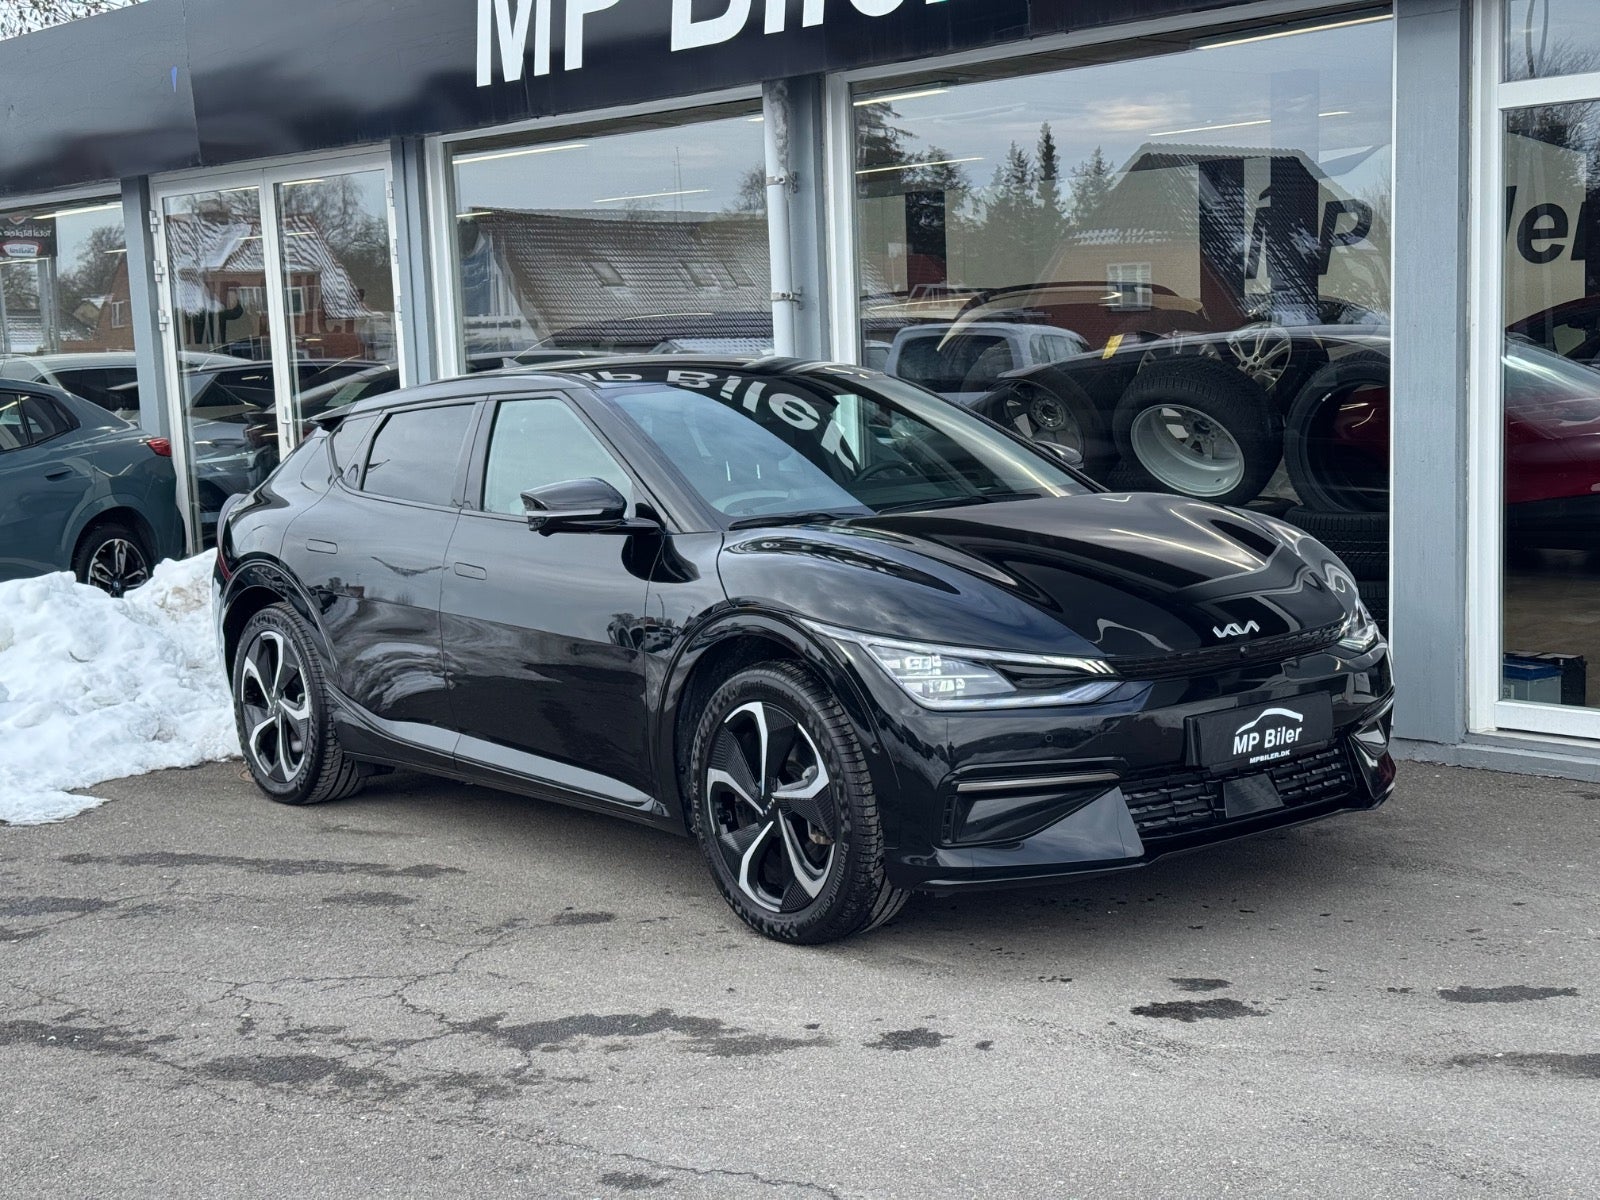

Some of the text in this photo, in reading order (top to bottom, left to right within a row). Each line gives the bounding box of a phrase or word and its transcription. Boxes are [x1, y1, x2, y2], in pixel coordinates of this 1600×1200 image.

[1213, 620, 1260, 638] KIA
[1233, 726, 1303, 755] MP Biler
[1249, 749, 1291, 764] MPBILER.DK
